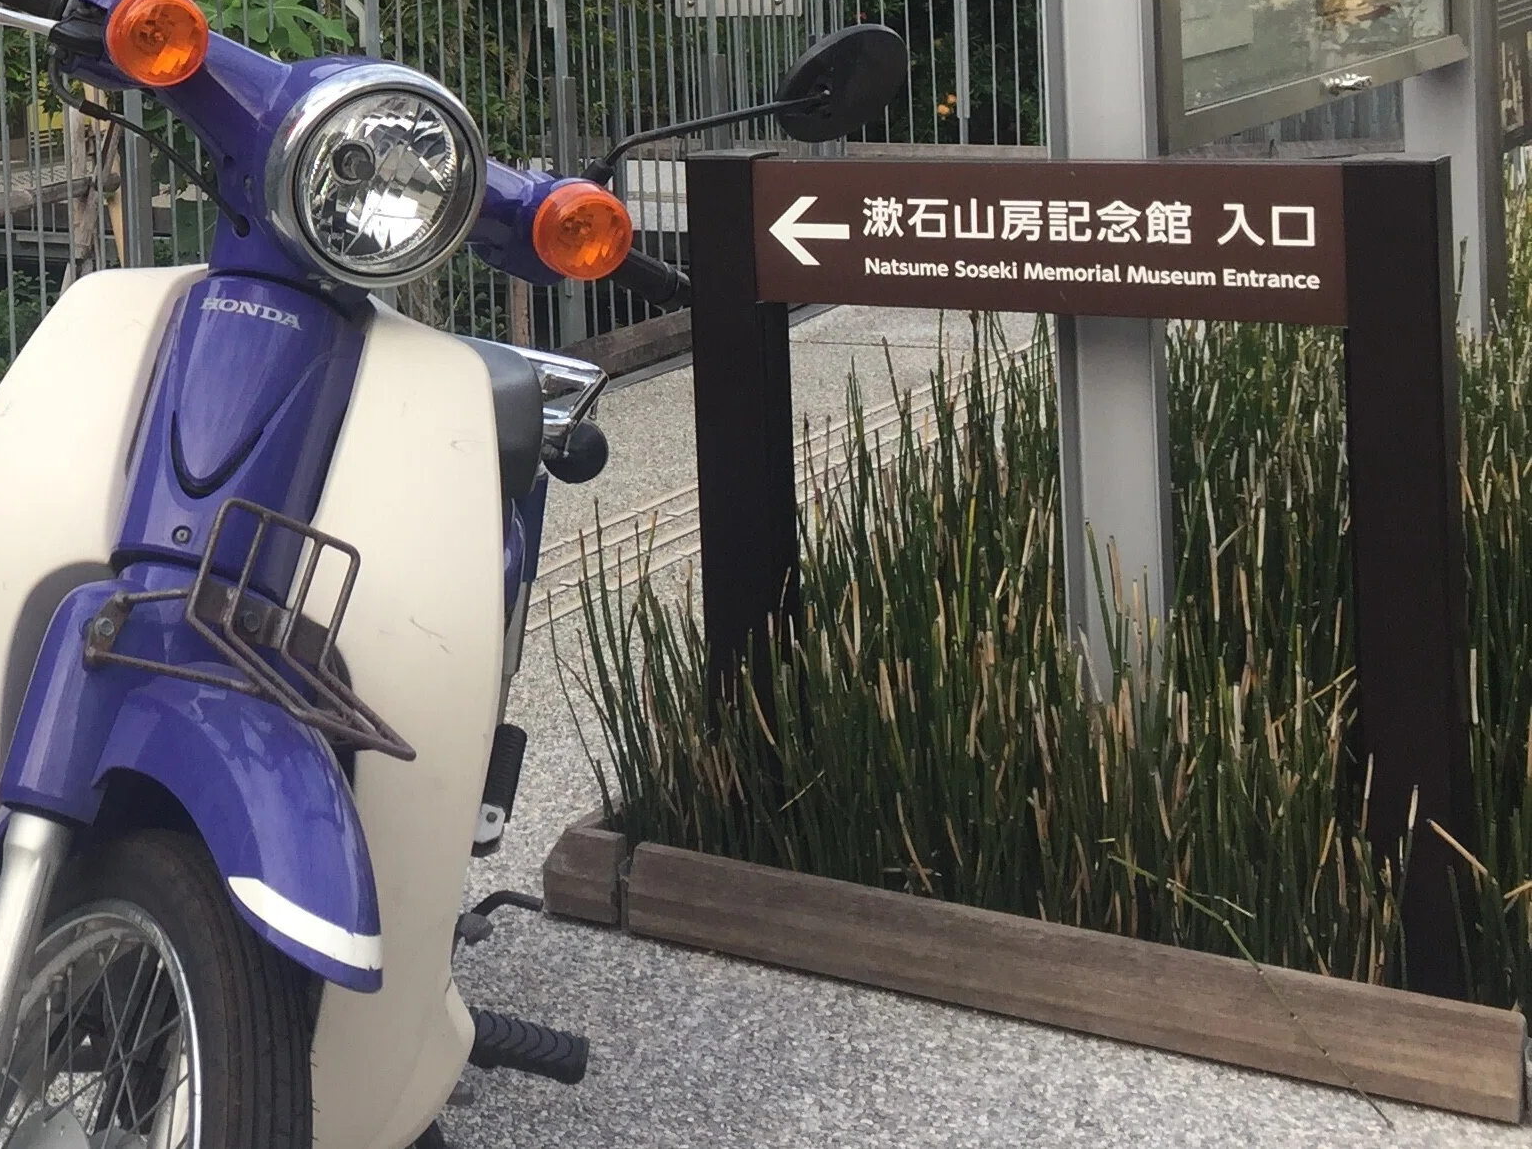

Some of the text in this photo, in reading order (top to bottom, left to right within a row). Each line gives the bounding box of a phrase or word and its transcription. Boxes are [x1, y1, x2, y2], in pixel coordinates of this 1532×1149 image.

[862, 196, 1316, 247] 漱石山房記念館 入口
[864, 257, 1321, 290] Natsume Soseki Memorial Museum Entrance
[200, 298, 302, 331] HONDA
